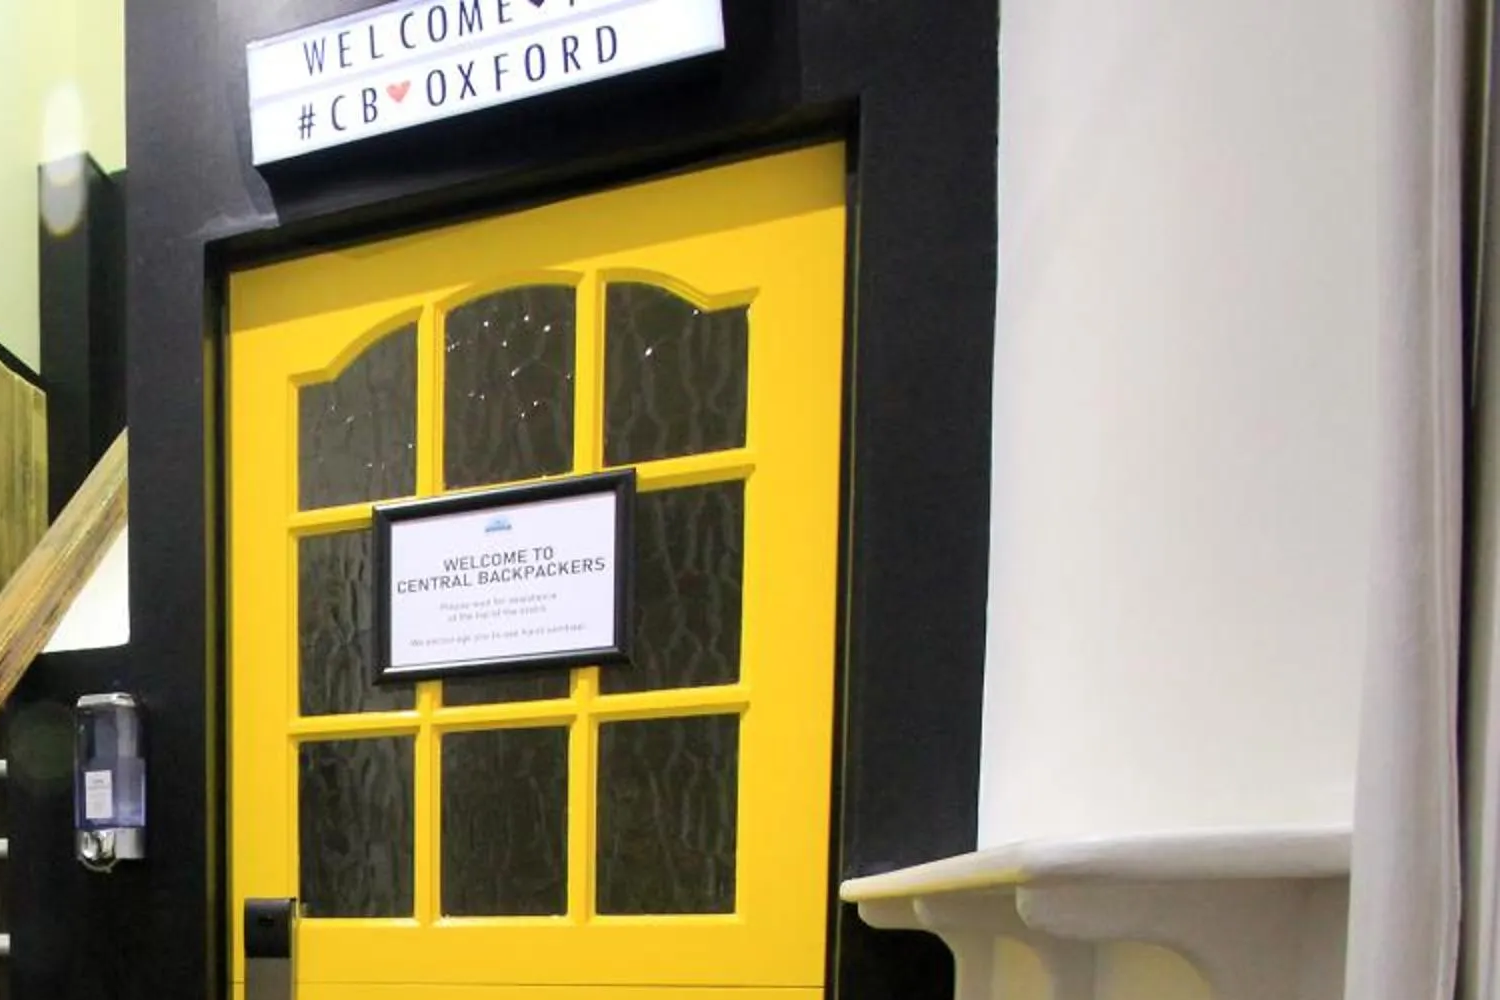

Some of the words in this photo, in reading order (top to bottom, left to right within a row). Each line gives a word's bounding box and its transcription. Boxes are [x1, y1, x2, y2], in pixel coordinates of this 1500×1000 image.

[426, 25, 617, 107] OXFORD
[397, 573, 473, 594] CENTRAL
[477, 557, 605, 585] BACKPACKERS
[443, 549, 527, 571] WELCOME
[532, 546, 554, 561] TO
